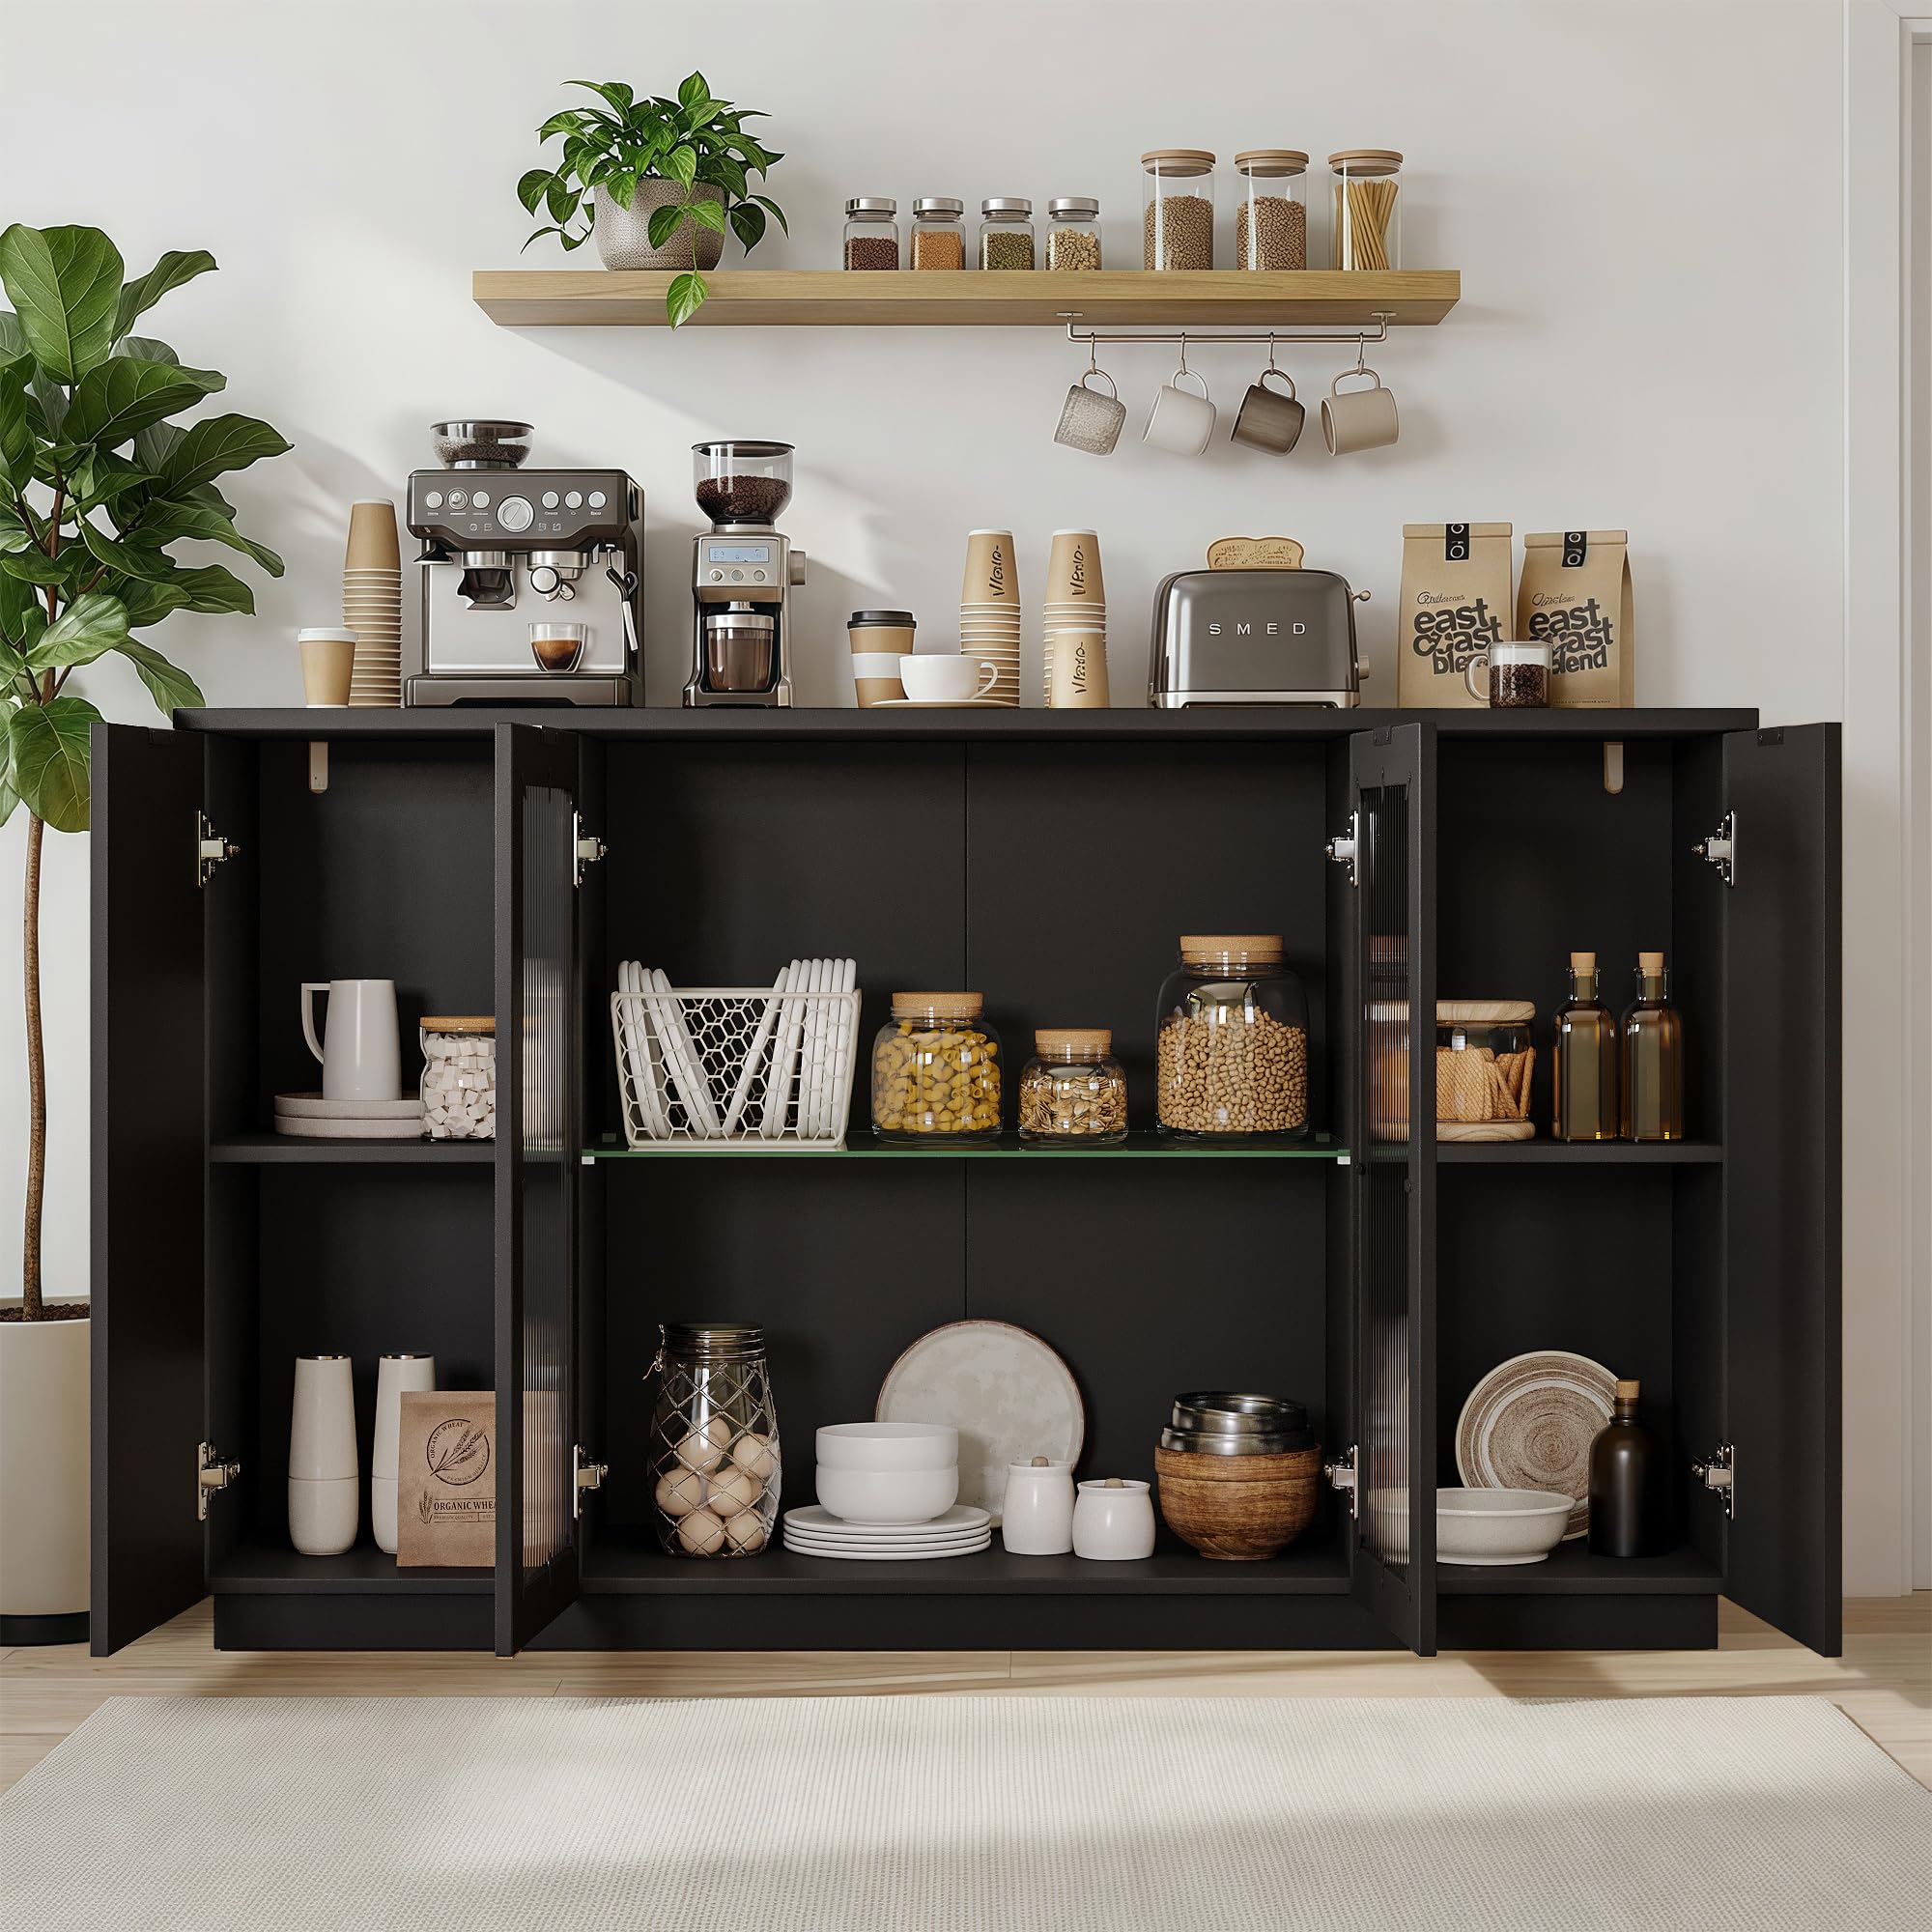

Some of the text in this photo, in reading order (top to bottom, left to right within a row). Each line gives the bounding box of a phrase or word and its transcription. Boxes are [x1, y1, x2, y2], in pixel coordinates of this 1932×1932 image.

[1414, 598, 1488, 634] east
[1529, 598, 1601, 637] east
[1208, 622, 1306, 636] SMED
[441, 1422, 464, 1432] WHEAT
[434, 1501, 471, 1511] ORGANIC
